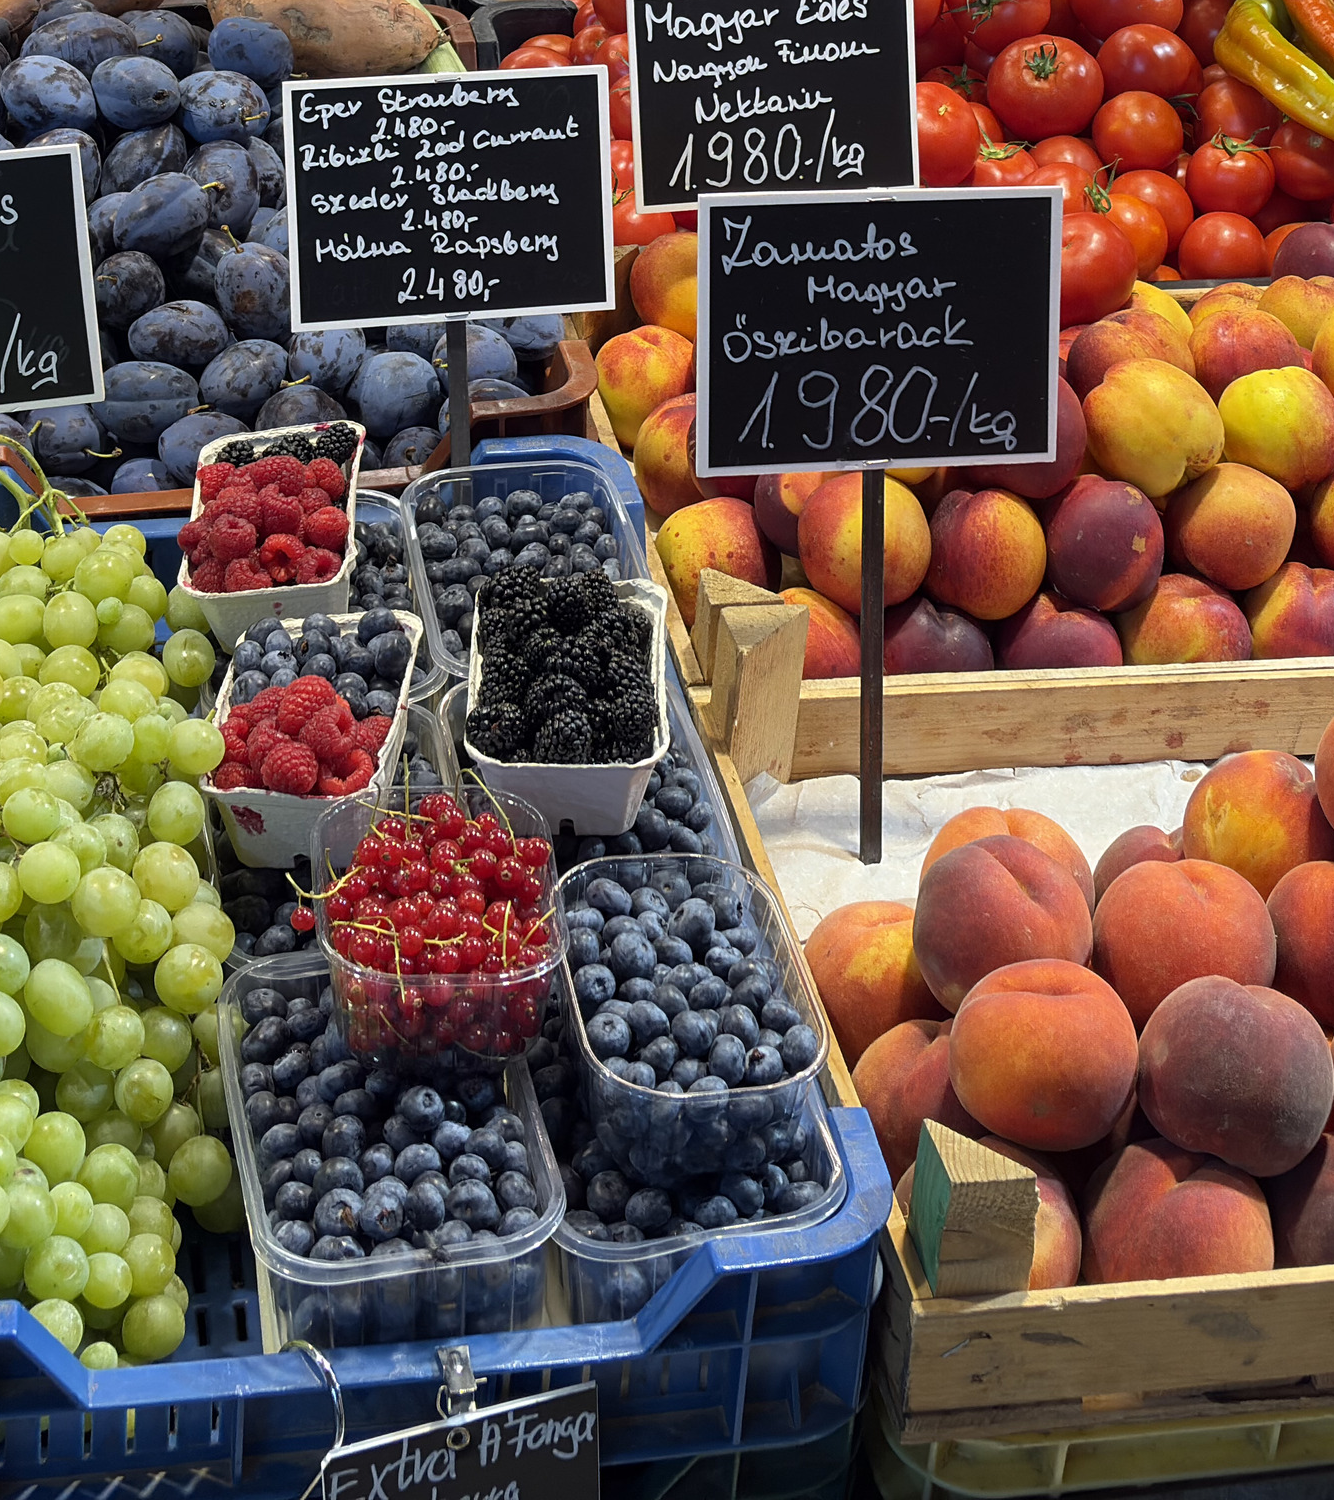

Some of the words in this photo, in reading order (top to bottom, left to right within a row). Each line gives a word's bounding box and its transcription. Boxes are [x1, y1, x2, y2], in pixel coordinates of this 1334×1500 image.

[645, 2, 779, 51] Magyar
[653, 54, 767, 88] Nagyon
[774, 39, 880, 64] Finom
[299, 92, 362, 129] Eper
[695, 87, 833, 124] Nektarin
[473, 115, 579, 150] Currant
[315, 233, 412, 263] Málna
[721, 215, 919, 275] Zamatos
[808, 275, 957, 314] Magyar
[722, 305, 973, 363] Őszibarack
